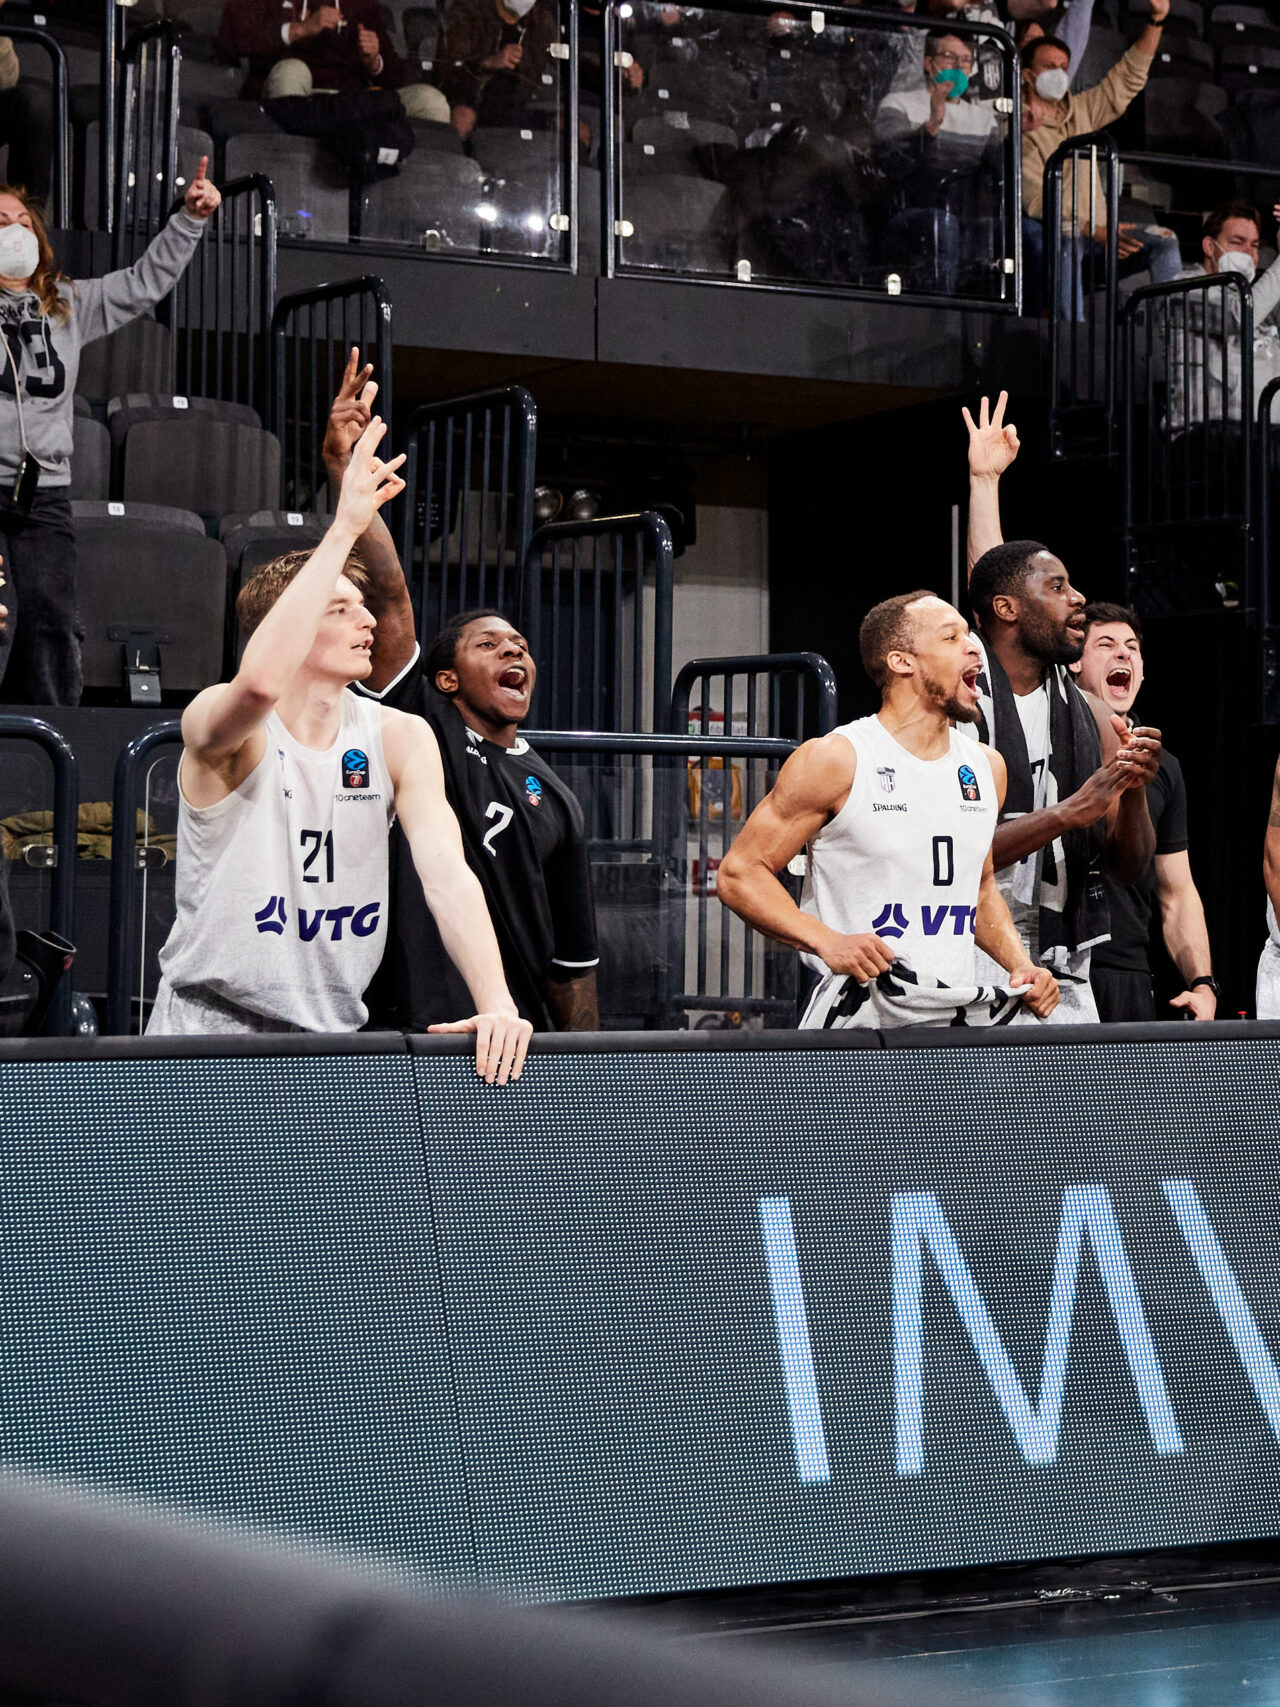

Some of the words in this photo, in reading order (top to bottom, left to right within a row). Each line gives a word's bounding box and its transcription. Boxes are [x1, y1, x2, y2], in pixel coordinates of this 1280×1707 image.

[483, 801, 514, 857] 2
[872, 803, 908, 812] SPALDING
[300, 829, 334, 883] 21
[932, 836, 954, 886] 0
[298, 902, 380, 942] VTG
